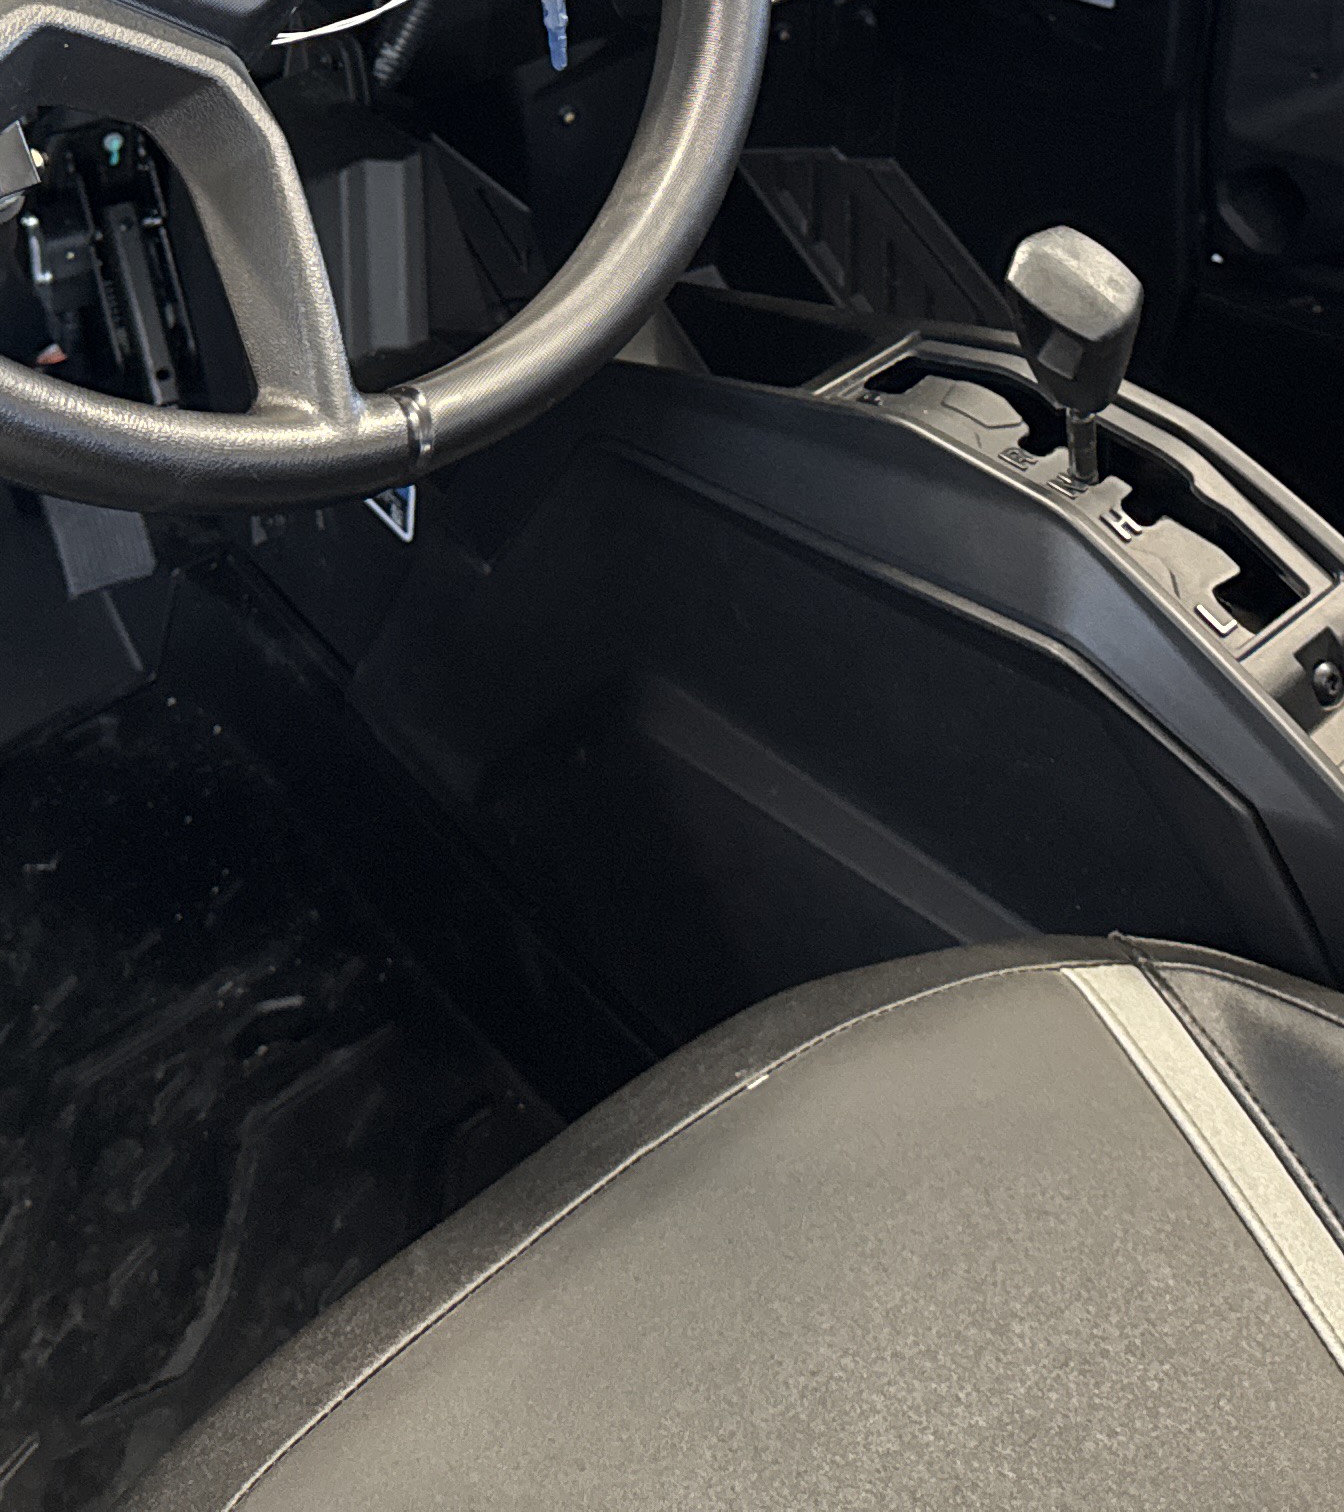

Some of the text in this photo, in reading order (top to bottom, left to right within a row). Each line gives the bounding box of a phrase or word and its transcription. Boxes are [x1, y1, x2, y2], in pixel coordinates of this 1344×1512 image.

[999, 447, 1038, 470] R
[1100, 507, 1142, 541] H
[1196, 604, 1238, 636] L
